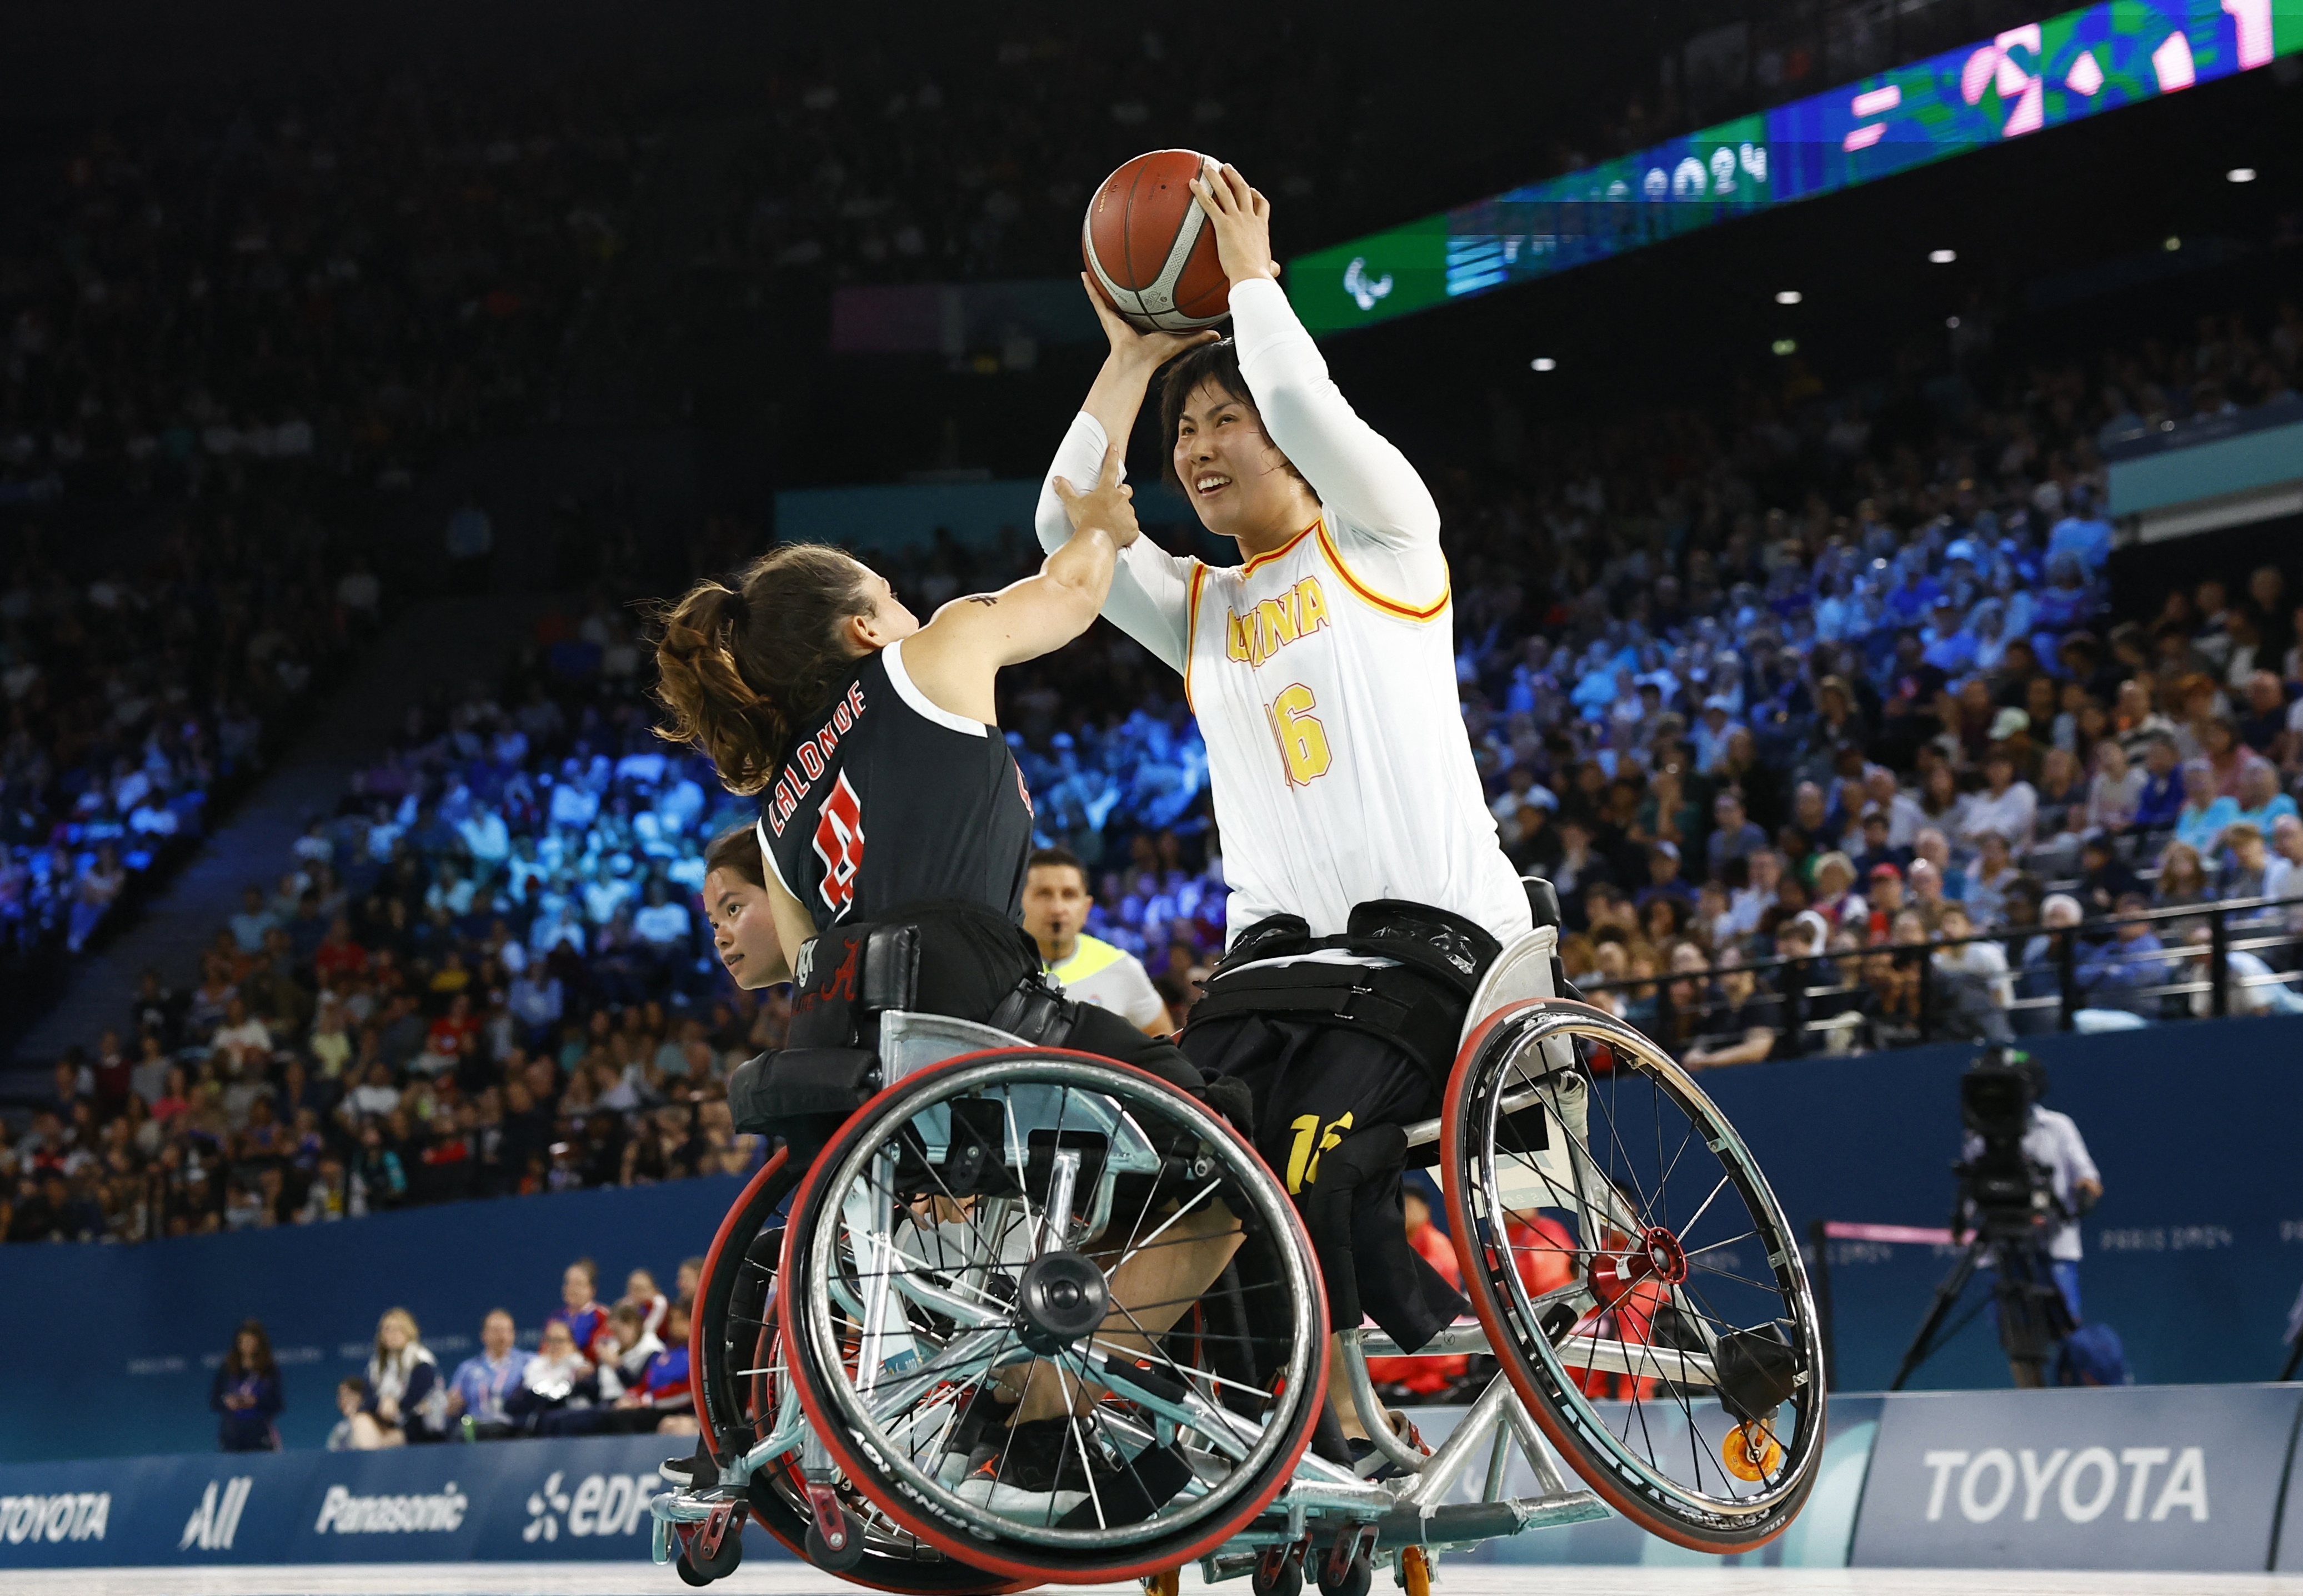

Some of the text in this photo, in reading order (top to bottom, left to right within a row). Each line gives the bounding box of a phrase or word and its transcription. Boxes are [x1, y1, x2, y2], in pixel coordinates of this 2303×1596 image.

[768, 679, 867, 838] LALONDE
[0, 1490, 111, 1545] TOYOTA
[313, 1480, 468, 1535] Panasonic
[1923, 1447, 2210, 1524] TOYOTA
